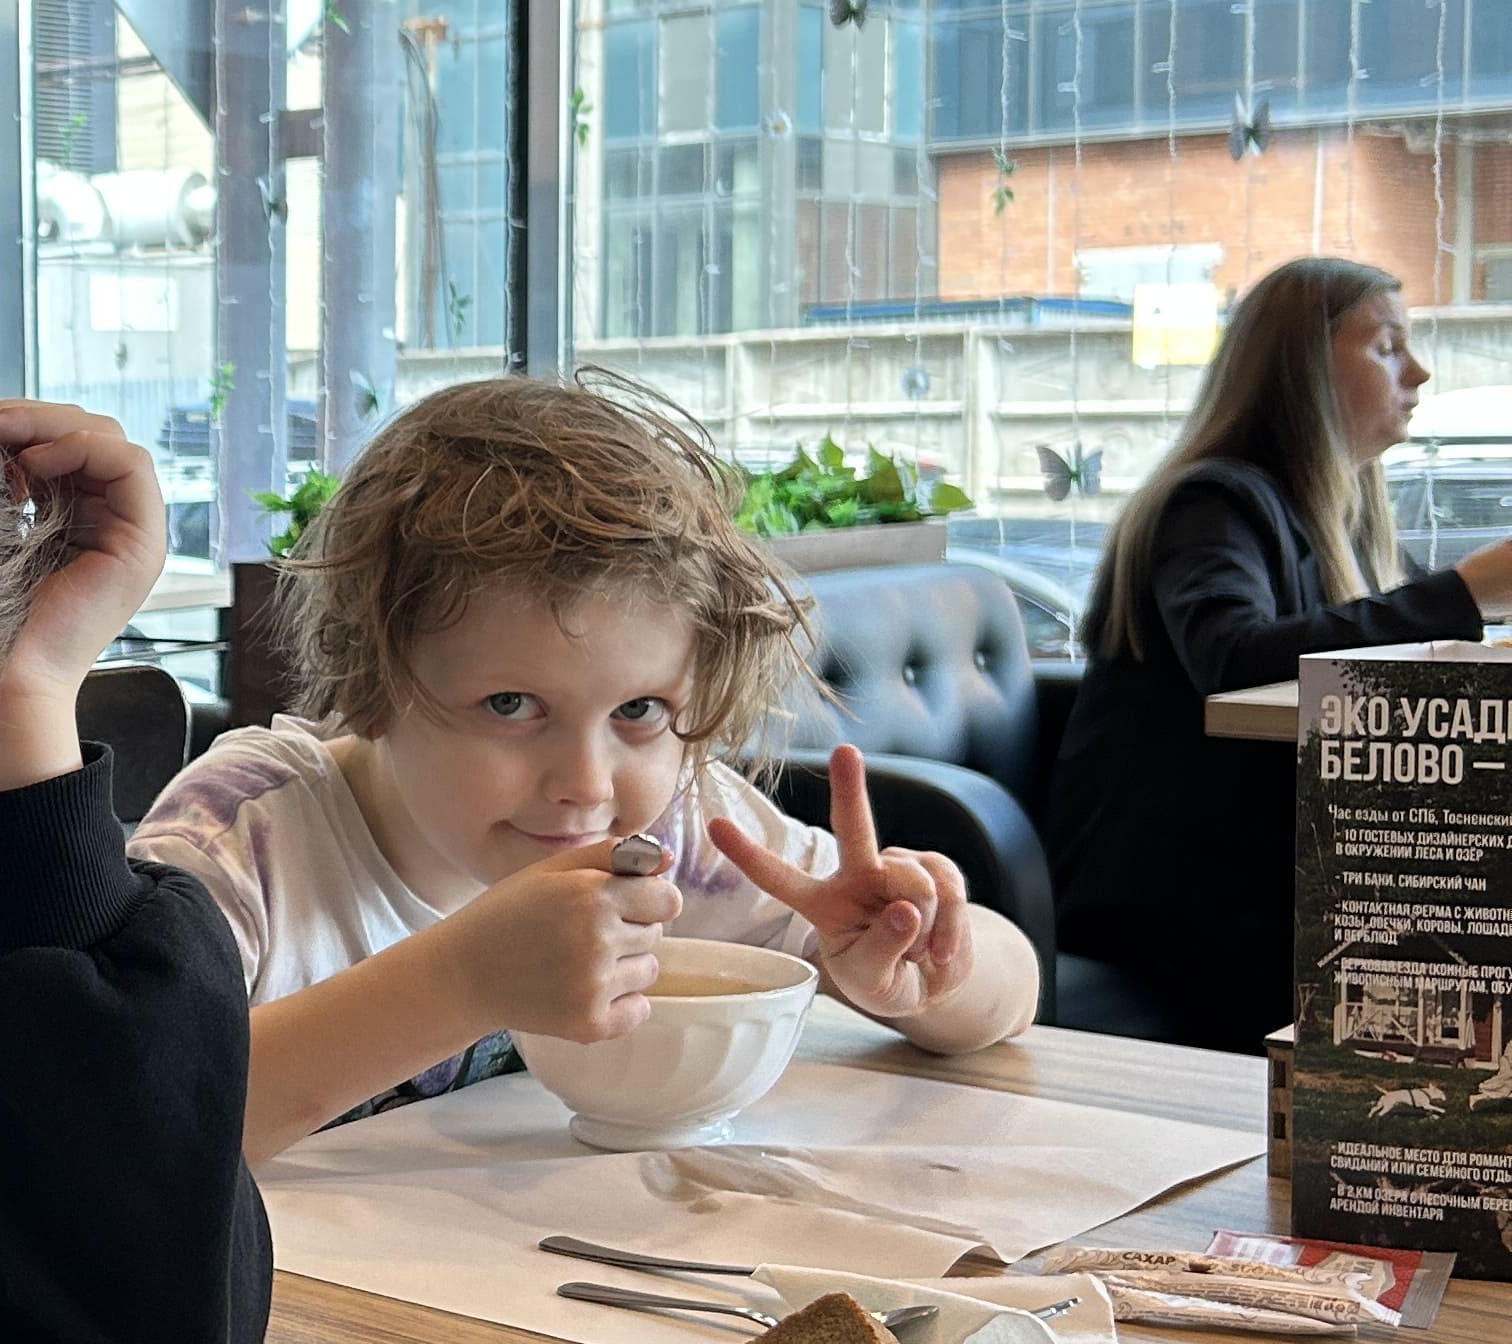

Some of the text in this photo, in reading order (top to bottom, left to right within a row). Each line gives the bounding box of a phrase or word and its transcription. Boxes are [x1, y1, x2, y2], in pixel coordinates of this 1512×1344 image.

[1320, 695, 1389, 736] ЭКО
[1320, 739, 1464, 785] БЕЛОВО
[1328, 804, 1352, 820] Час
[1355, 808, 1388, 823] езды
[1392, 810, 1406, 822] от
[1409, 808, 1439, 825] СПб,
[1344, 829, 1357, 842] 10
[1359, 829, 1415, 844] ГОСТЕВЫХ
[1416, 831, 1504, 848] ДИЗАЙНЕРСКИХ
[1335, 843, 1484, 862] В ОКРУЖЕНИИ ЛЕСА И ОЗЁР
[1343, 871, 1487, 892] ТРИ БАНИ, СИБИРСКИЙ ЧАН
[1342, 900, 1410, 916] КОНТАКТНАЯ
[1412, 903, 1452, 918] ФЕРМА
[1454, 906, 1462, 919] С
[1416, 919, 1465, 935] КОРОВЫ,
[1334, 928, 1399, 946] И ВЕРБЛЮД
[1334, 971, 1413, 989] ЖИВОПИСНЫМ
[1338, 1142, 1403, 1160] ИДЕАЛЬНОЕ
[1404, 1148, 1440, 1163] МЕСТО
[1442, 1151, 1467, 1166] ДЛЯ
[1330, 1155, 1389, 1173] СВИДАНИЙ
[1391, 1161, 1415, 1175] ИЛИ
[1416, 1163, 1481, 1181] СЕМЕЙНОГО
[1329, 1198, 1444, 1222] АРЕНДОЙ ИНВЕНТАРЯ
[1420, 1192, 1480, 1209] ПЕСОЧНЫМ
[1121, 1250, 1177, 1266] САХАР
